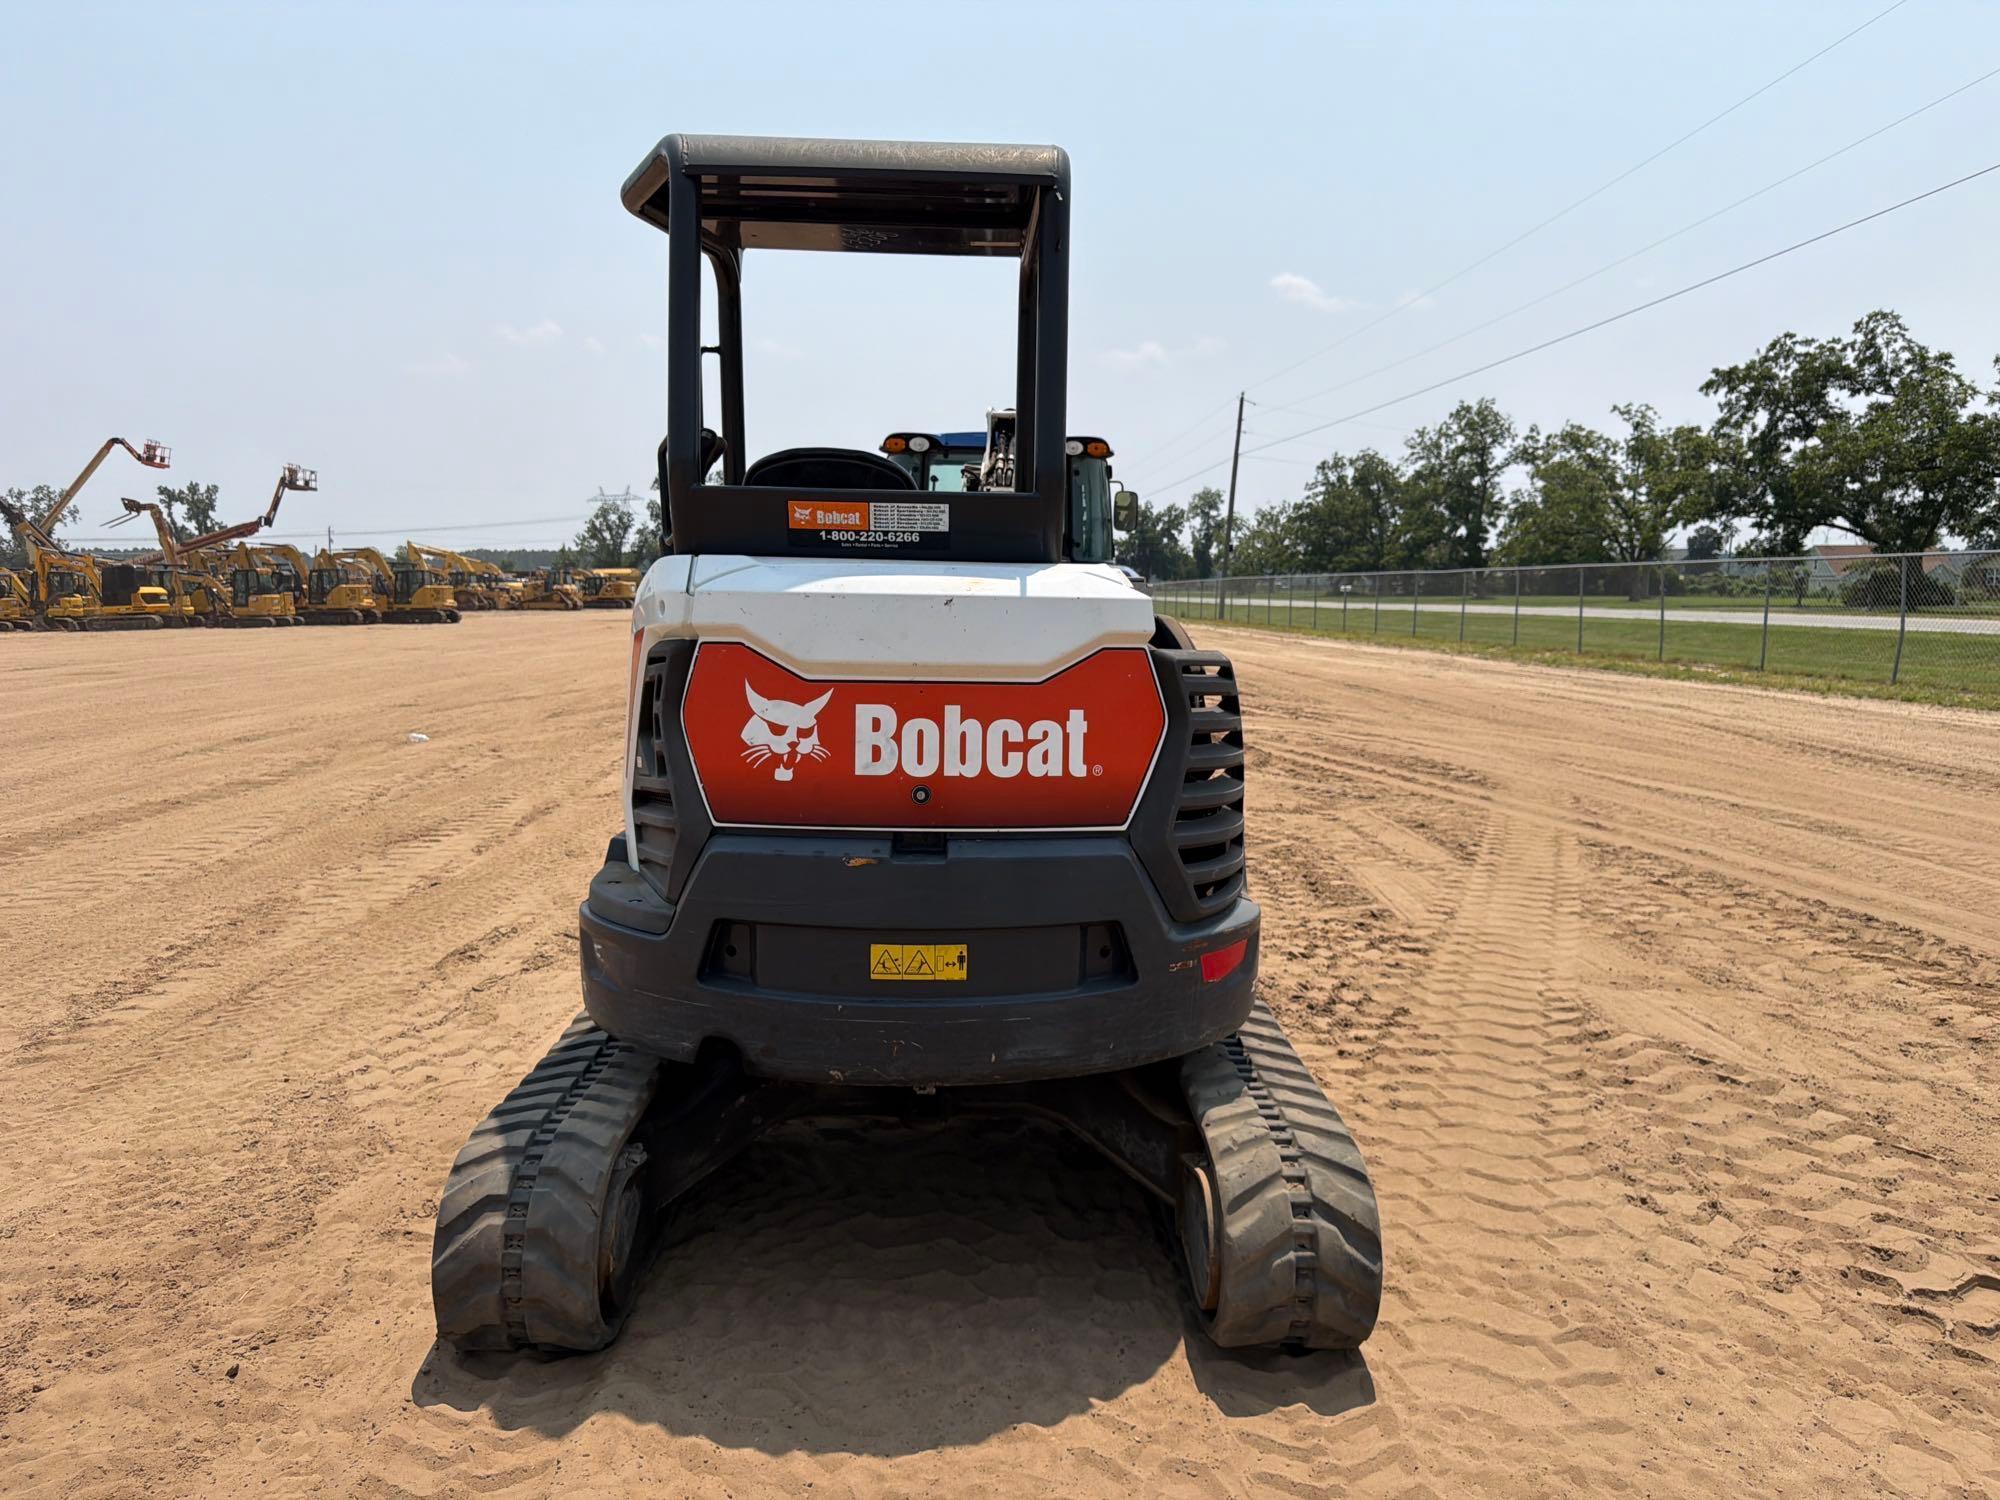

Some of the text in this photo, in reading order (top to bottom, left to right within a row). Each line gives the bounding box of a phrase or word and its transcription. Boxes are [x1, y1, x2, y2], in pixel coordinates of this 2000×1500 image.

[816, 510, 861, 525] Bobcat
[819, 530, 920, 542] 1-800-220-6266
[855, 703, 1088, 778] Bobcat
